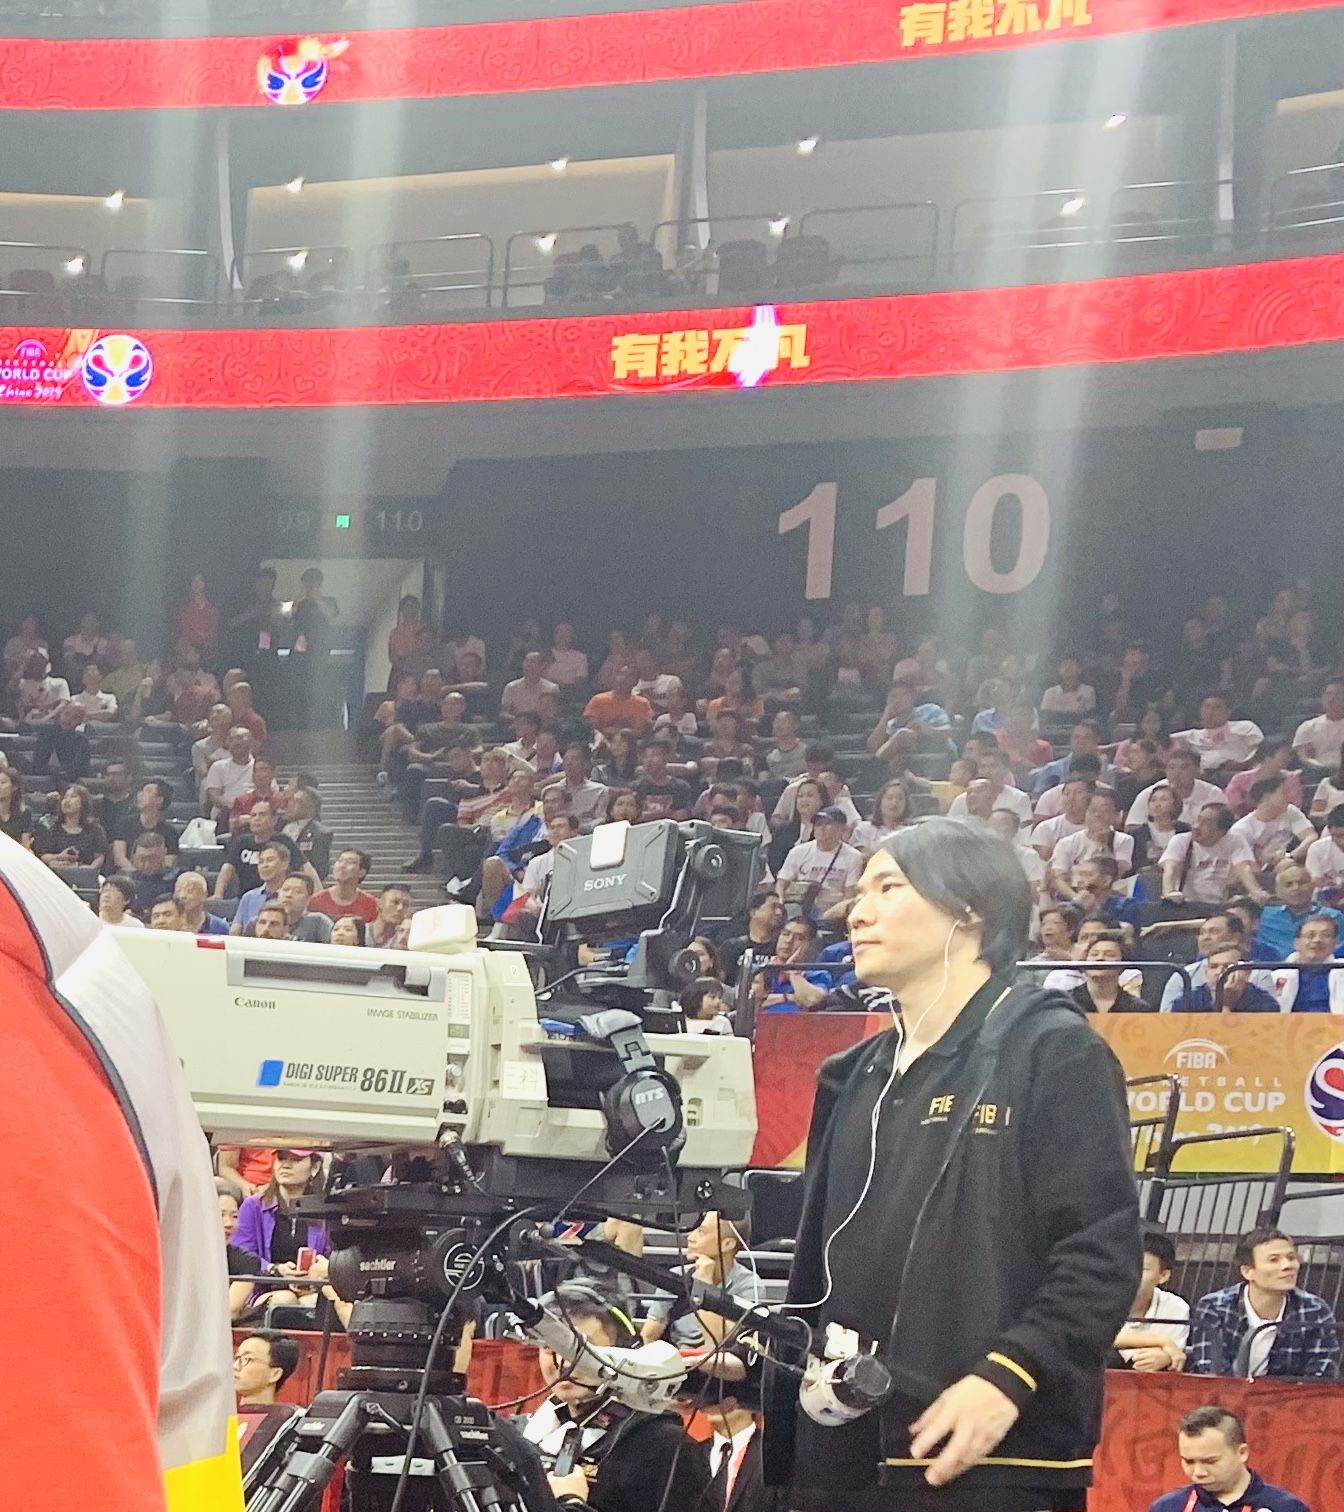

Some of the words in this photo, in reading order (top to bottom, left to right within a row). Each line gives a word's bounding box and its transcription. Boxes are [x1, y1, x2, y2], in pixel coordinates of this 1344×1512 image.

[43, 368, 73, 381] CUP
[777, 473, 1050, 599] 110
[583, 874, 627, 891] SONY
[234, 996, 277, 1010] Canon
[366, 1008, 395, 1019] IMAGE
[1176, 1051, 1217, 1069] FIBA
[285, 1062, 314, 1081] DIGI
[315, 1064, 359, 1084] SUPER
[634, 1086, 665, 1105] RTS
[1224, 1091, 1286, 1113] CUP
